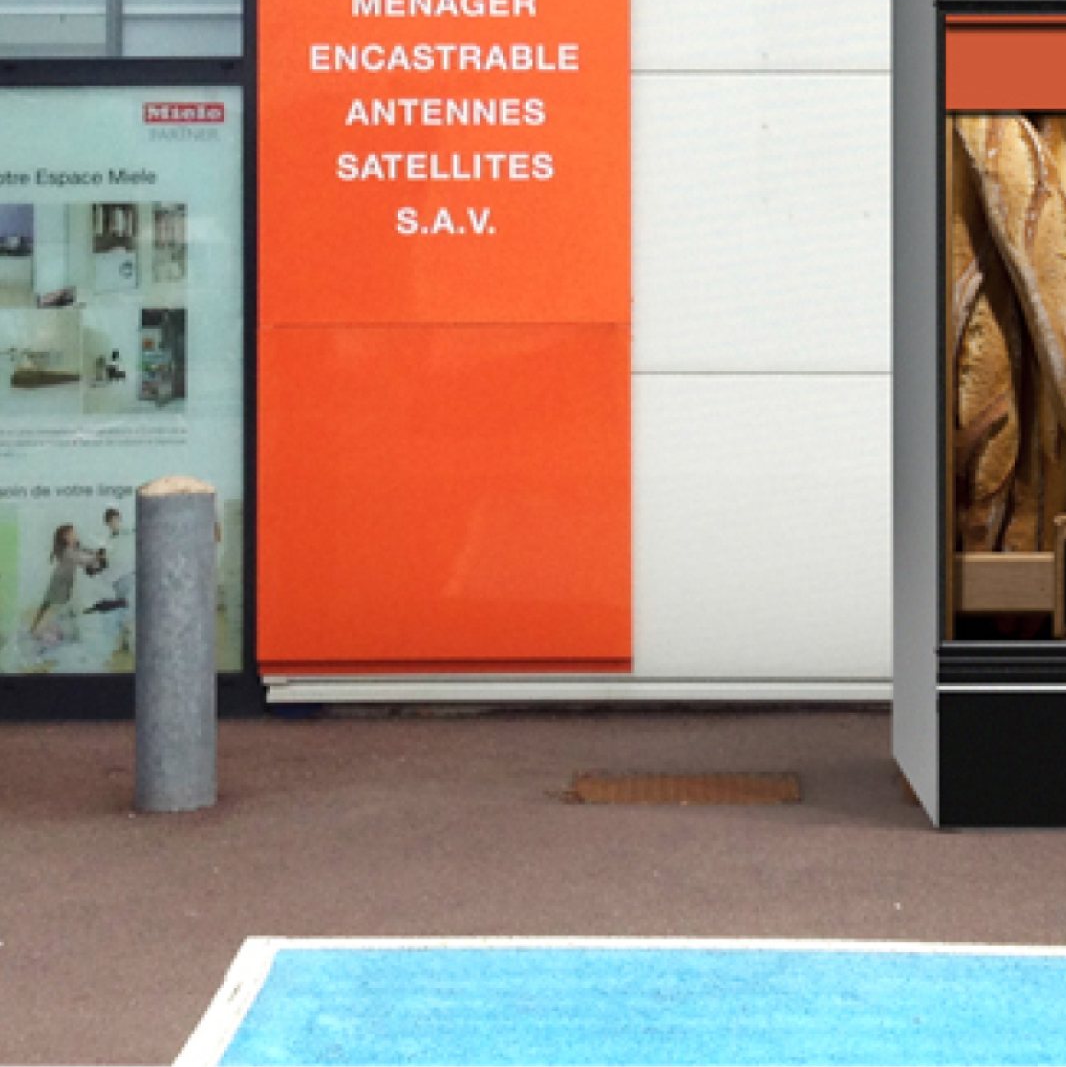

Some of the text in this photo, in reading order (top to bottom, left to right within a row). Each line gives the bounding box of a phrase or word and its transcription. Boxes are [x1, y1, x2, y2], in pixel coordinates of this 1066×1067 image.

[309, 43, 579, 72] ENCASTRABLE
[345, 97, 546, 126] ANTENNES
[36, 167, 103, 188] Espace
[336, 151, 555, 181] SATELLITES
[396, 206, 496, 235] S.A.V.
